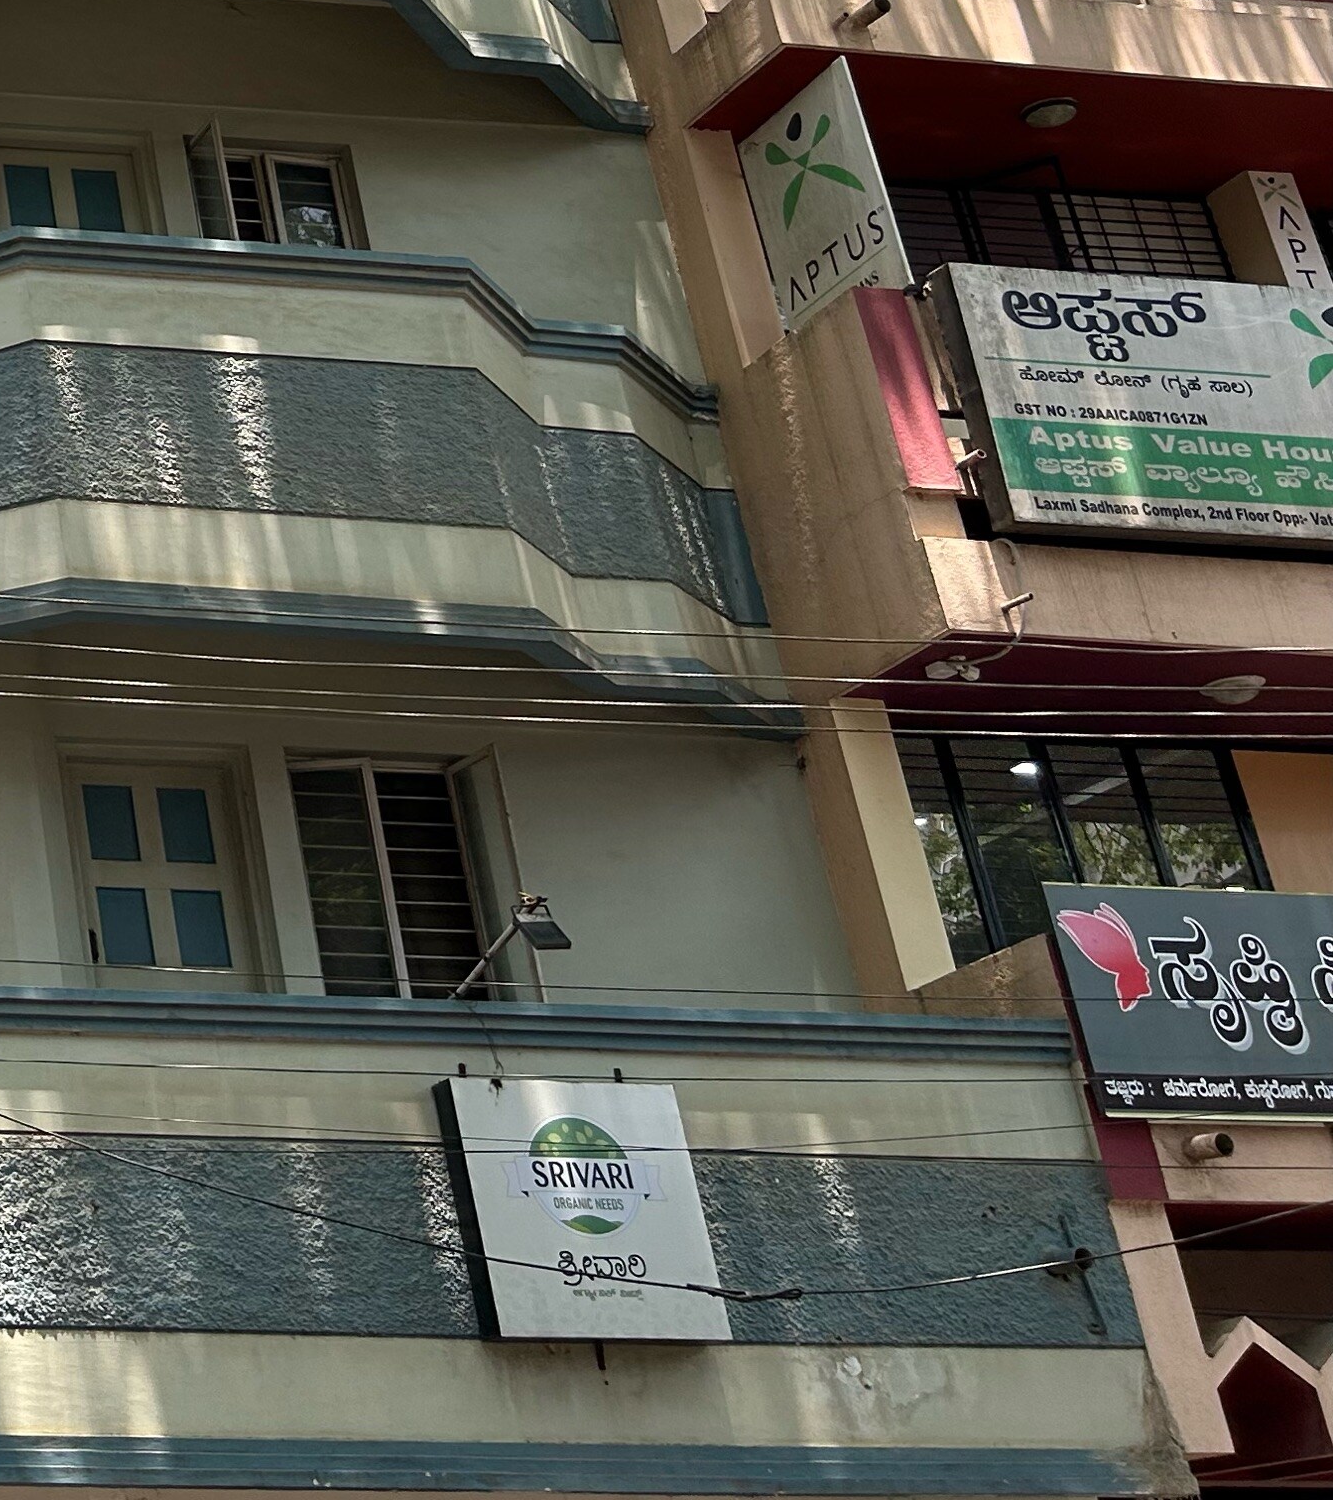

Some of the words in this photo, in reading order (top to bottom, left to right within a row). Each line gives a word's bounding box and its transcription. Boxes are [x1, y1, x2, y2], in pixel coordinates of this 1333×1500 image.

[1001, 288, 1207, 363] ಆಪ್ಟಸ್
[1019, 366, 1084, 385] ಹೋಮ್
[1094, 370, 1151, 388] ಲೋನ್
[1161, 375, 1202, 398] (ಗೃಹ
[1209, 380, 1253, 398] ಸಾಲ)
[1014, 403, 1041, 416] GST
[1047, 405, 1067, 418] NO
[1029, 425, 1134, 452] Aptus
[1149, 432, 1252, 459] Value
[1261, 439, 1333, 462] Hou
[1035, 455, 1128, 488] ಆಪ್ಟಸ್
[1034, 496, 1077, 512] Laxmi
[1081, 498, 1138, 516] Sadhana
[1141, 503, 1205, 522] Complex,
[1207, 505, 1233, 521] 2nd
[1235, 508, 1270, 522] Floor
[532, 1160, 635, 1189] SRIVARI
[553, 1197, 594, 1210] ORGANIC
[595, 1198, 625, 1211] NEEDS
[557, 1250, 647, 1286] ಶ್ರೀವಾರಿ
